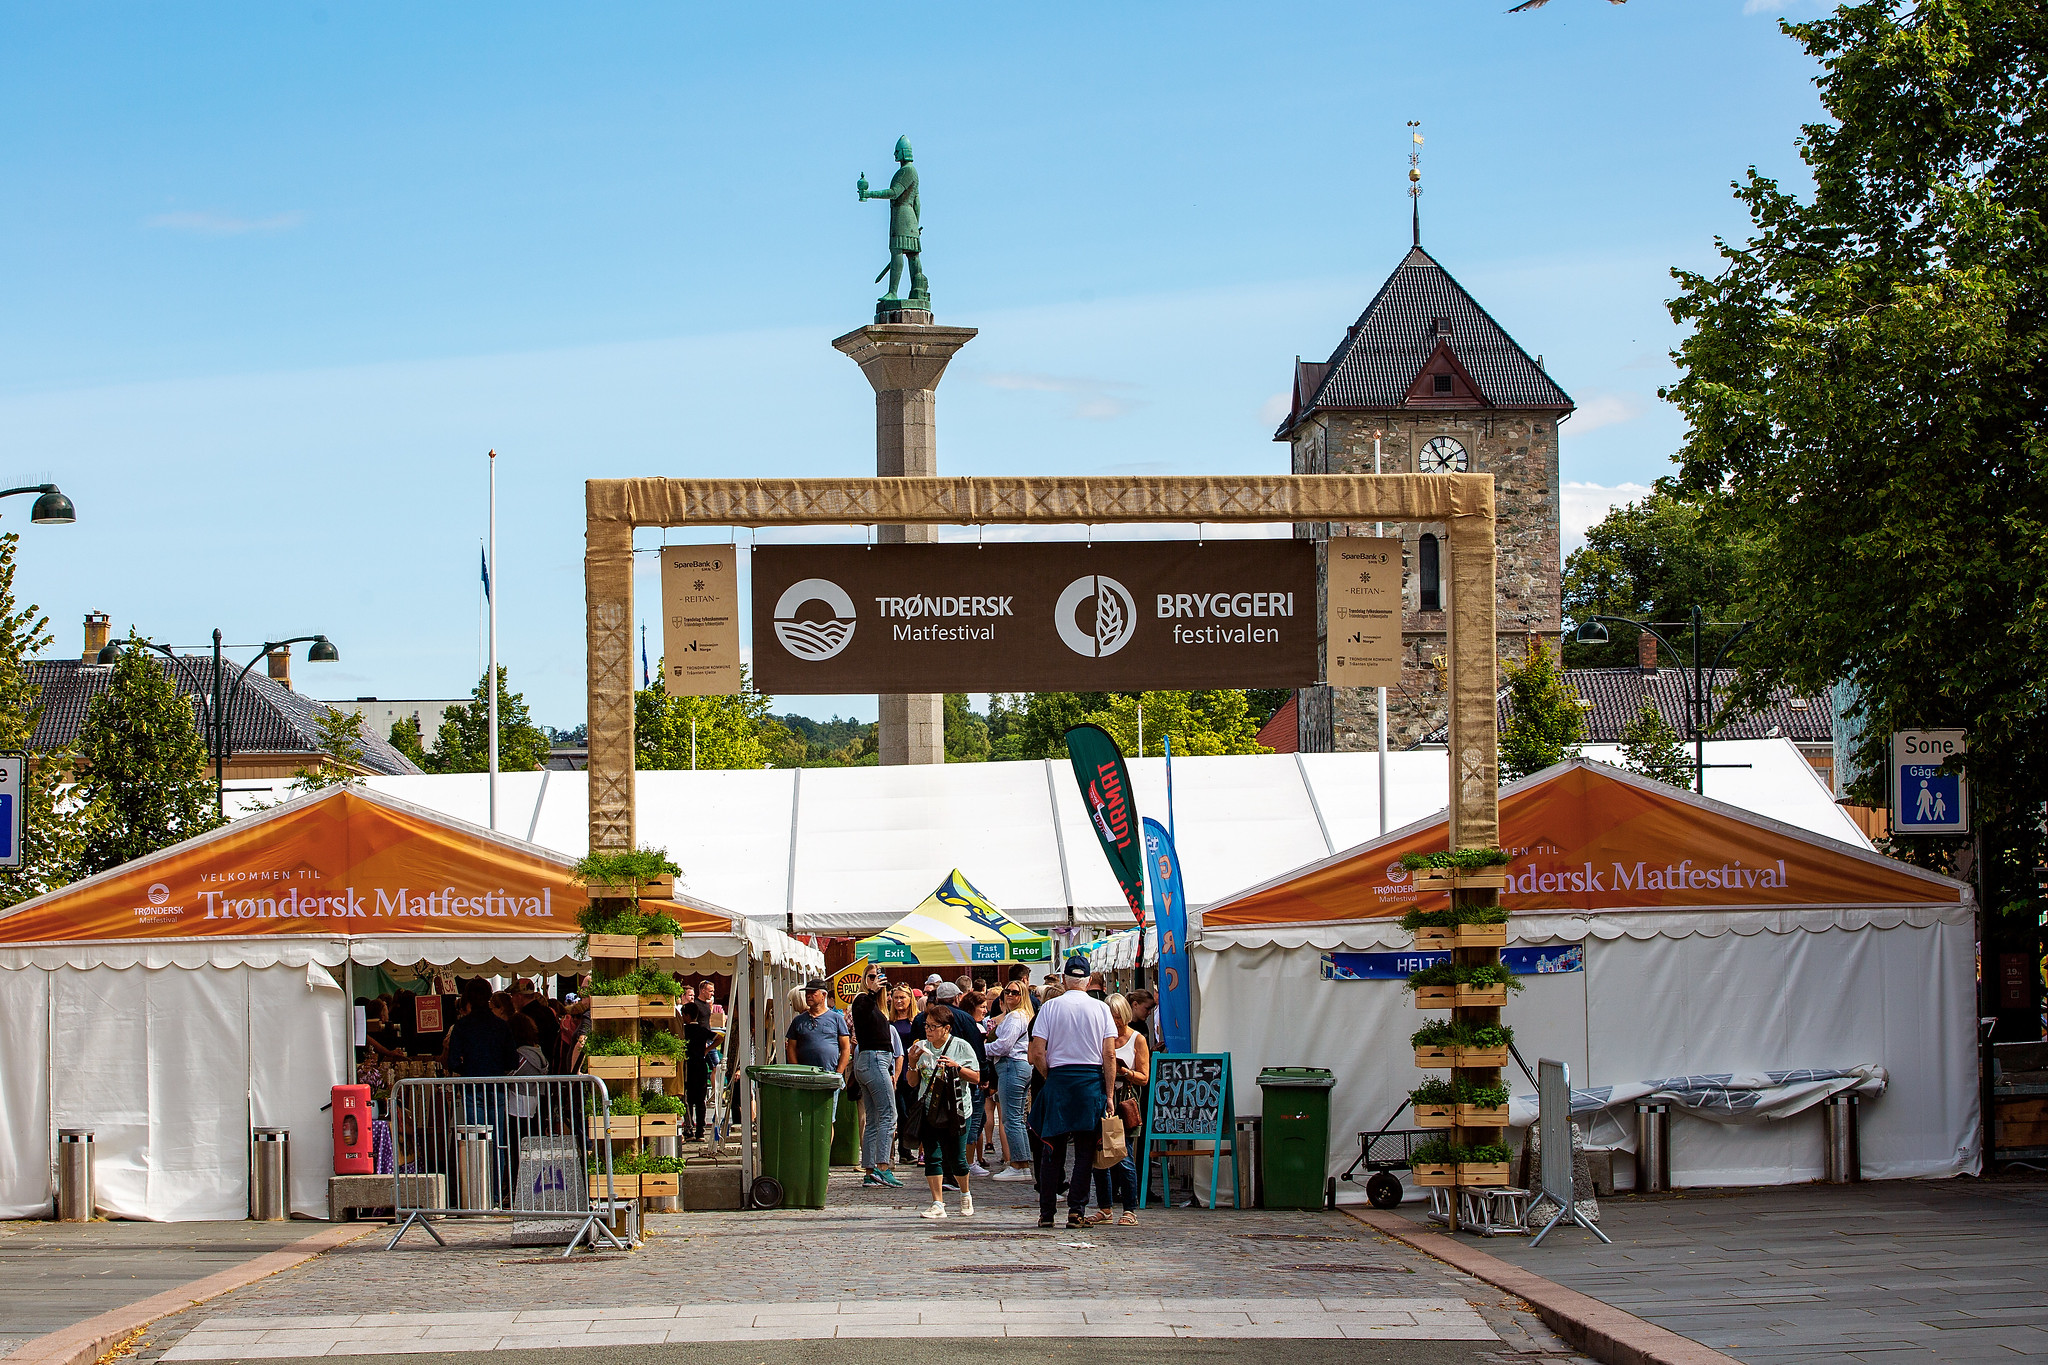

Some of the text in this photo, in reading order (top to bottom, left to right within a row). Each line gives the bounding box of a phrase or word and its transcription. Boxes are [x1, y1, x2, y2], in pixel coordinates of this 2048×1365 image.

[673, 561, 710, 569] SpareBank
[1350, 587, 1380, 595] REITAN
[684, 595, 715, 603] REITAN
[1156, 592, 1294, 618] BRYGGERI
[875, 594, 1014, 620] TRØNDERSK
[893, 623, 995, 642] Matfestival
[1173, 623, 1280, 644] festivalen
[1905, 736, 1954, 754] Sone
[1097, 760, 1131, 854] TURMAT
[1537, 846, 1559, 855] TIL
[200, 870, 321, 882] VELKOMMEN TIL
[1499, 859, 1788, 895] ndersk Matfestival
[1372, 885, 1415, 895] TRØNDER
[197, 886, 554, 920] Trøndersk Matfestival
[1379, 895, 1418, 903] Matfestival
[133, 906, 184, 916] TRØNDERSK
[139, 916, 178, 924] Matfestival
[884, 949, 904, 958] Exit
[976, 951, 1001, 959] Track
[1012, 947, 1040, 955] Enter
[1162, 1060, 1203, 1080] EKTE
[1155, 1079, 1220, 1107] GYROS
[1154, 1105, 1218, 1121] LAGET AV
[1155, 1118, 1217, 1134] GREKERE
